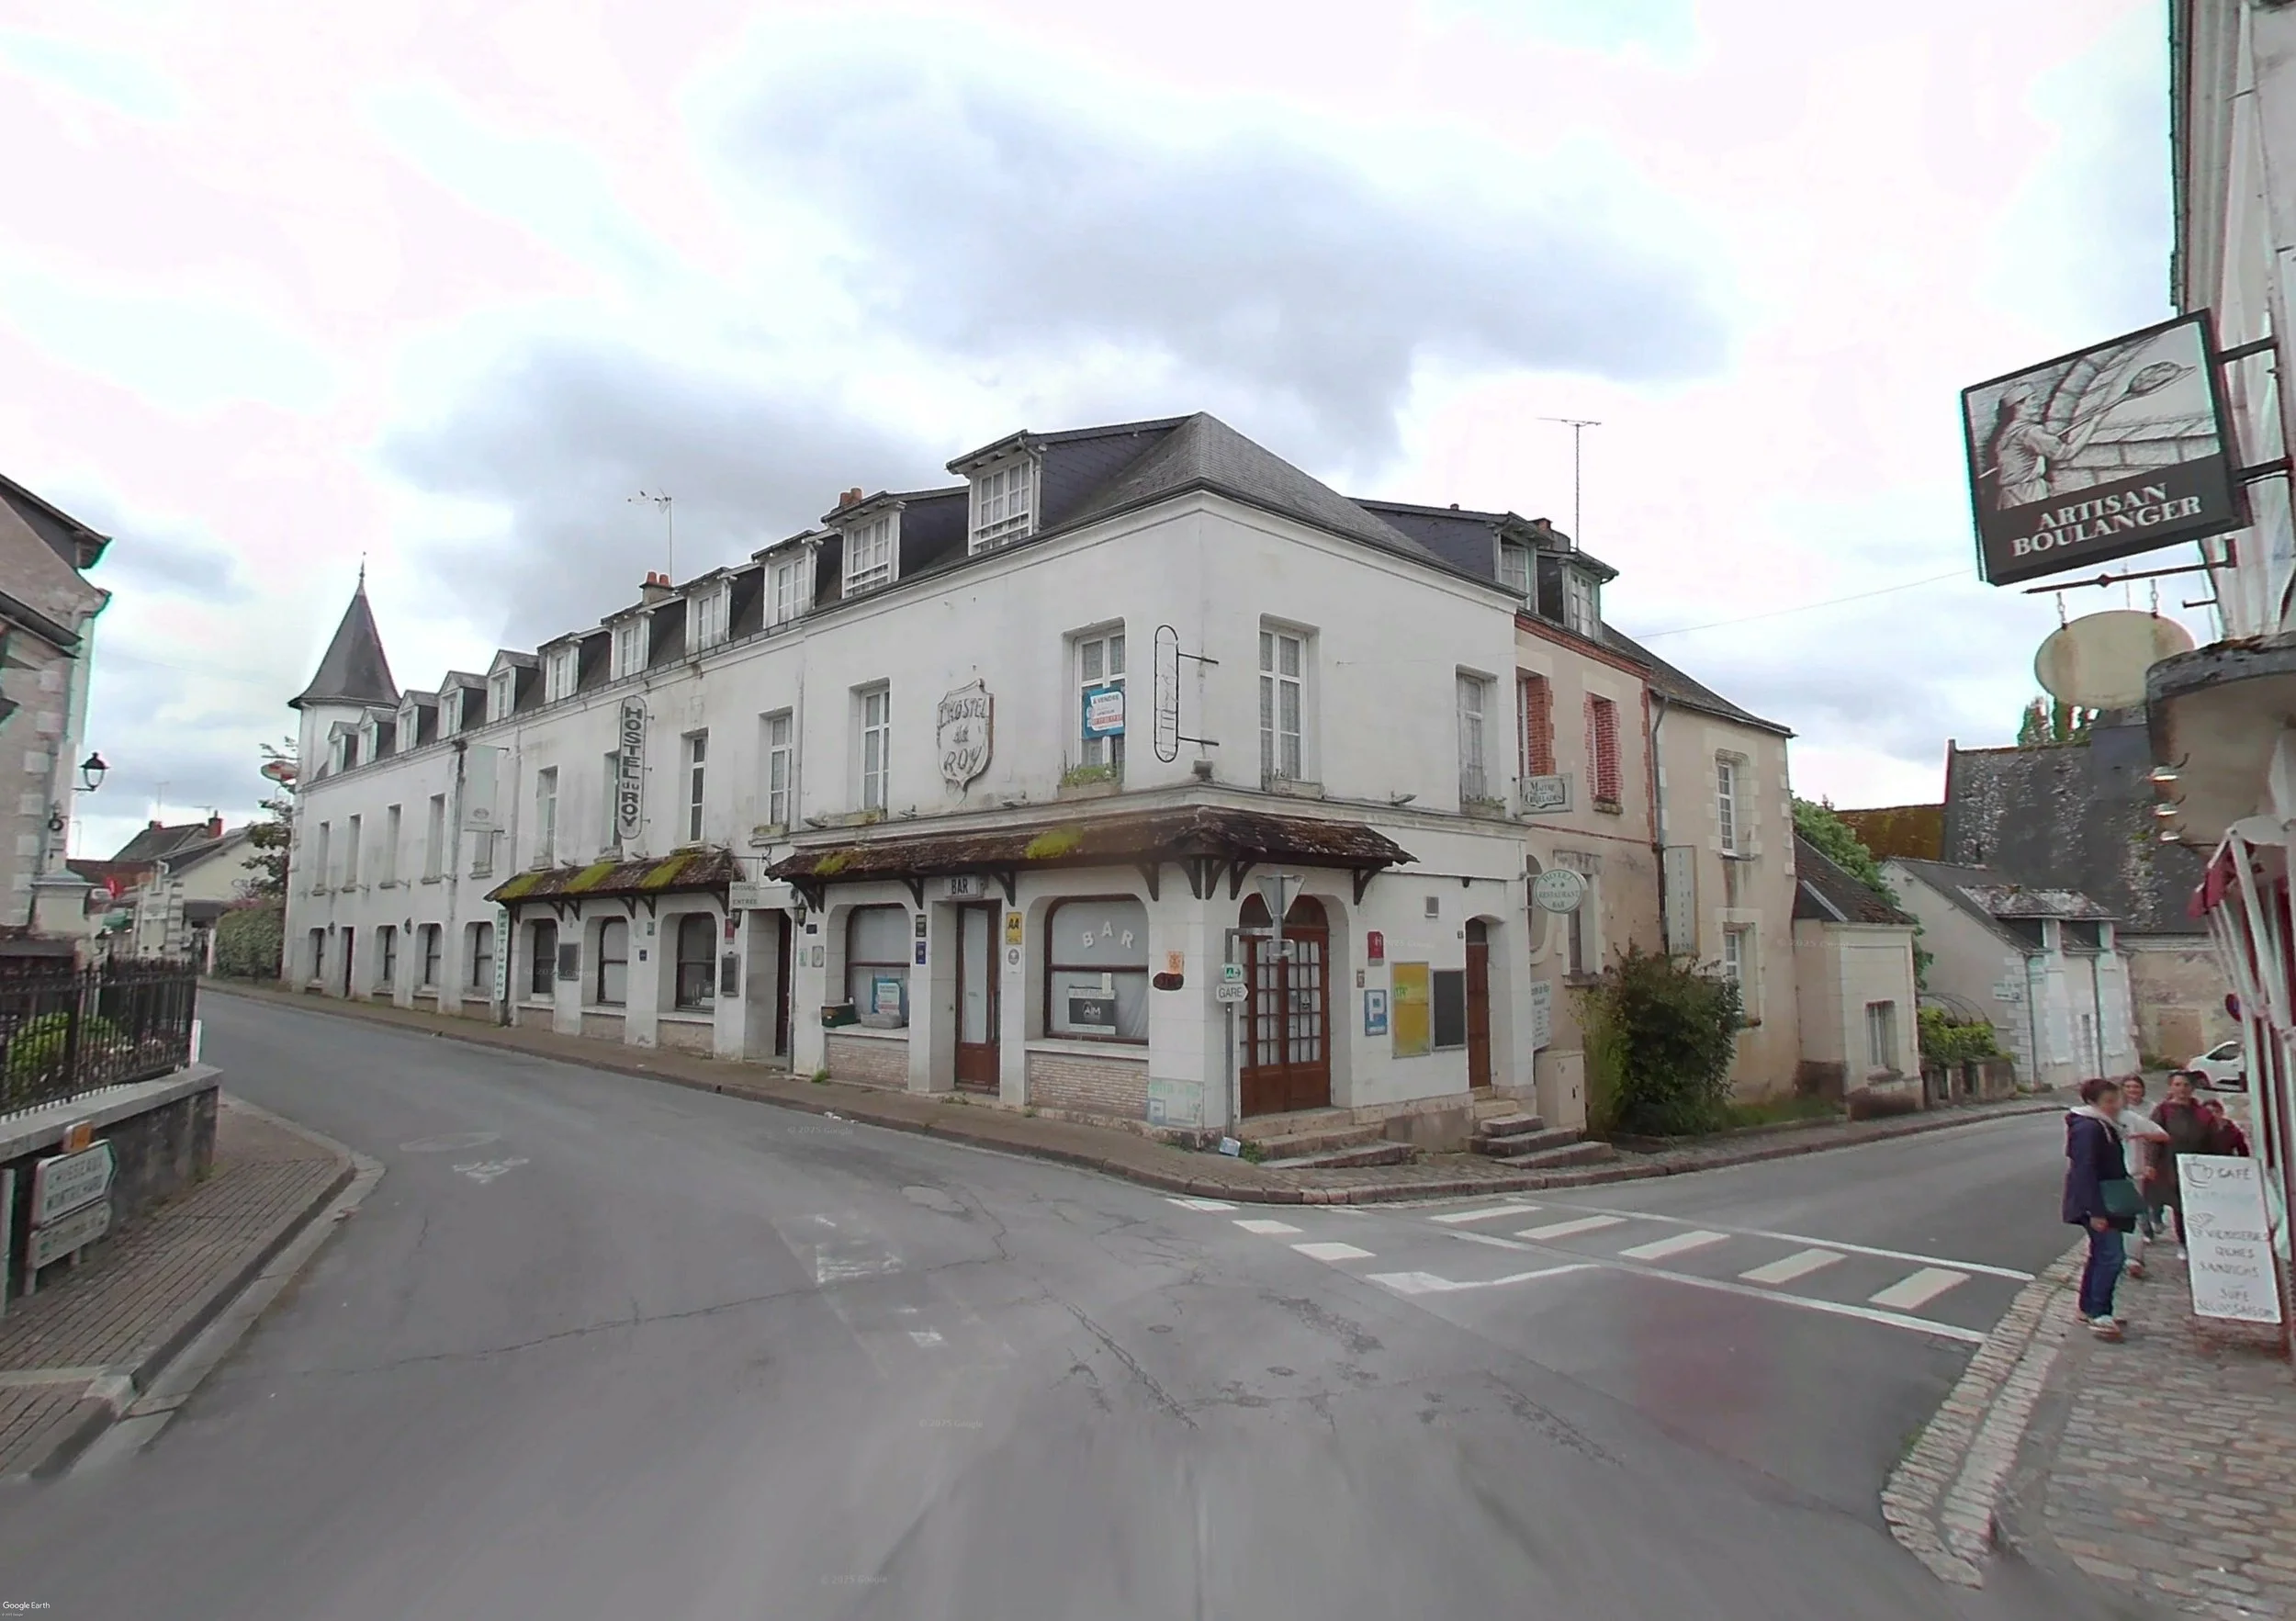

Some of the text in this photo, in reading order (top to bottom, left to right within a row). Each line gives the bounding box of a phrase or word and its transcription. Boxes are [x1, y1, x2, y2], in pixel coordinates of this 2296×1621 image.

[2037, 482, 2167, 531] ARTISAN
[2011, 496, 2202, 557] BOULANGER
[621, 707, 643, 827] HOSTEL du ROY
[943, 745, 983, 777] ROY
[951, 878, 969, 895] BAR
[1538, 890, 1580, 899] RESTAURANT
[1008, 918, 1019, 929] AA
[1082, 920, 1134, 949] BAR
[496, 913, 508, 996] RESTAURANT
[1219, 986, 1243, 998] GARE
